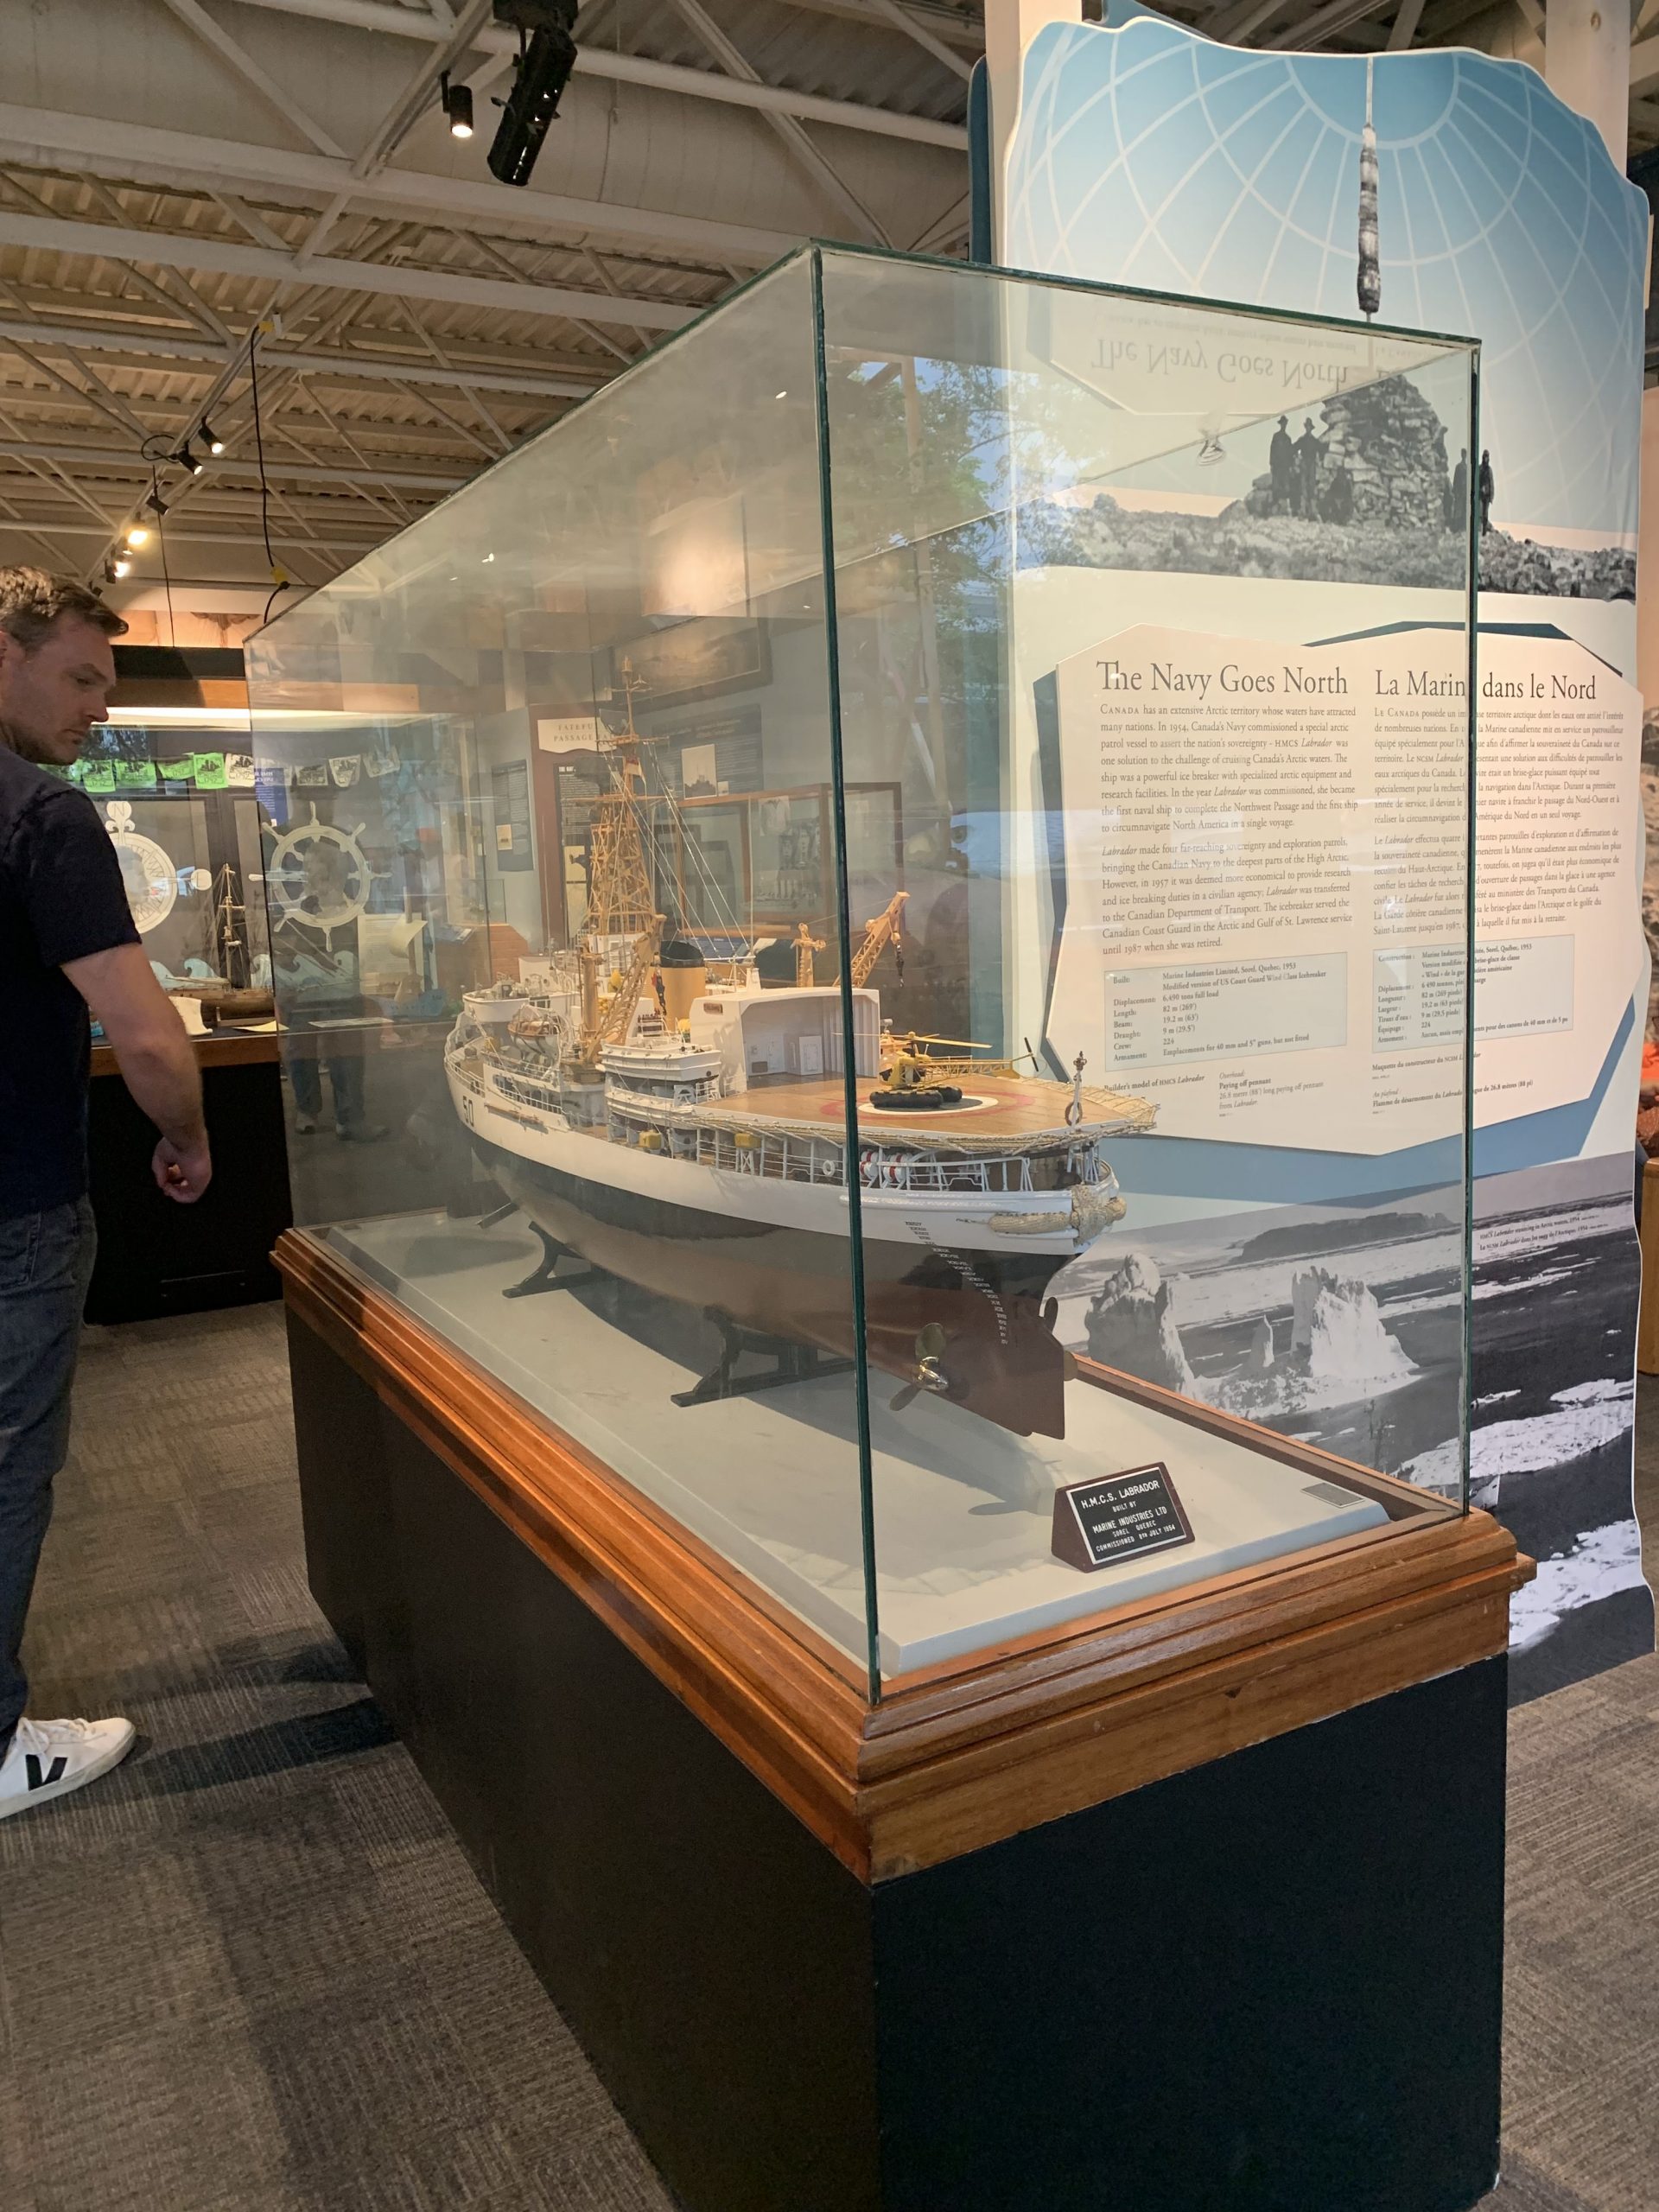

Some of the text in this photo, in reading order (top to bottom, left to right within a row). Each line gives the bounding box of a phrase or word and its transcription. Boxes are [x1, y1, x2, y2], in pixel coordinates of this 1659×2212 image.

[1096, 660, 1348, 699] The Navy Goes North
[1376, 669, 1465, 696] La Marin
[1482, 672, 1596, 699] dans le Nord
[1100, 703, 1356, 717] CANADA has an extensive Arctic territory whose waters have attracted
[1374, 707, 1385, 717] LE
[1386, 707, 1420, 717] CANADA
[1421, 707, 1446, 720] possède
[1100, 721, 1349, 734] many nations. In 1954, Canada's Navy commissioned a special arctic
[1101, 737, 1124, 751] patrol
[1126, 737, 1147, 748] vessel
[1183, 737, 1196, 747] the
[1197, 737, 1225, 747] nation's
[1227, 738, 1268, 750] sovereignty
[1274, 739, 1299, 747] HMCS
[1300, 736, 1333, 747] Labrador
[1102, 879, 1139, 889] However,
[1141, 878, 1149, 887] in
[1152, 878, 1169, 888] 1957
[1171, 876, 1177, 886] it
[1194, 873, 1224, 884] deemed
[1245, 869, 1286, 882] economical
[1287, 872, 1295, 881] to
[1296, 868, 1323, 882] provide
[1324, 868, 1351, 877] research
[1102, 897, 1350, 923] to the Canadian Department of Transport. The icebreaker served the
[1103, 943, 1122, 955] until
[1124, 943, 1142, 955] 1987
[1143, 941, 1165, 954] when
[1166, 939, 1179, 952] she
[1196, 937, 1223, 948] retired.
[1113, 1008, 1138, 1019] Length:
[1218, 1078, 1270, 1090] Paying off pennant
[1081, 1480, 1160, 1509] H.M.C.S. LABRADOR
[1112, 1504, 1128, 1513] BUILT
[1092, 1506, 1167, 1534] MARINE INDUSTRIES LTD
[1112, 1520, 1157, 1538] SOREL QUEBEC
[1096, 1537, 1135, 1553] COMMISSIONED
[1149, 1528, 1162, 1537] JULY
[1163, 1524, 1176, 1533] 1954
